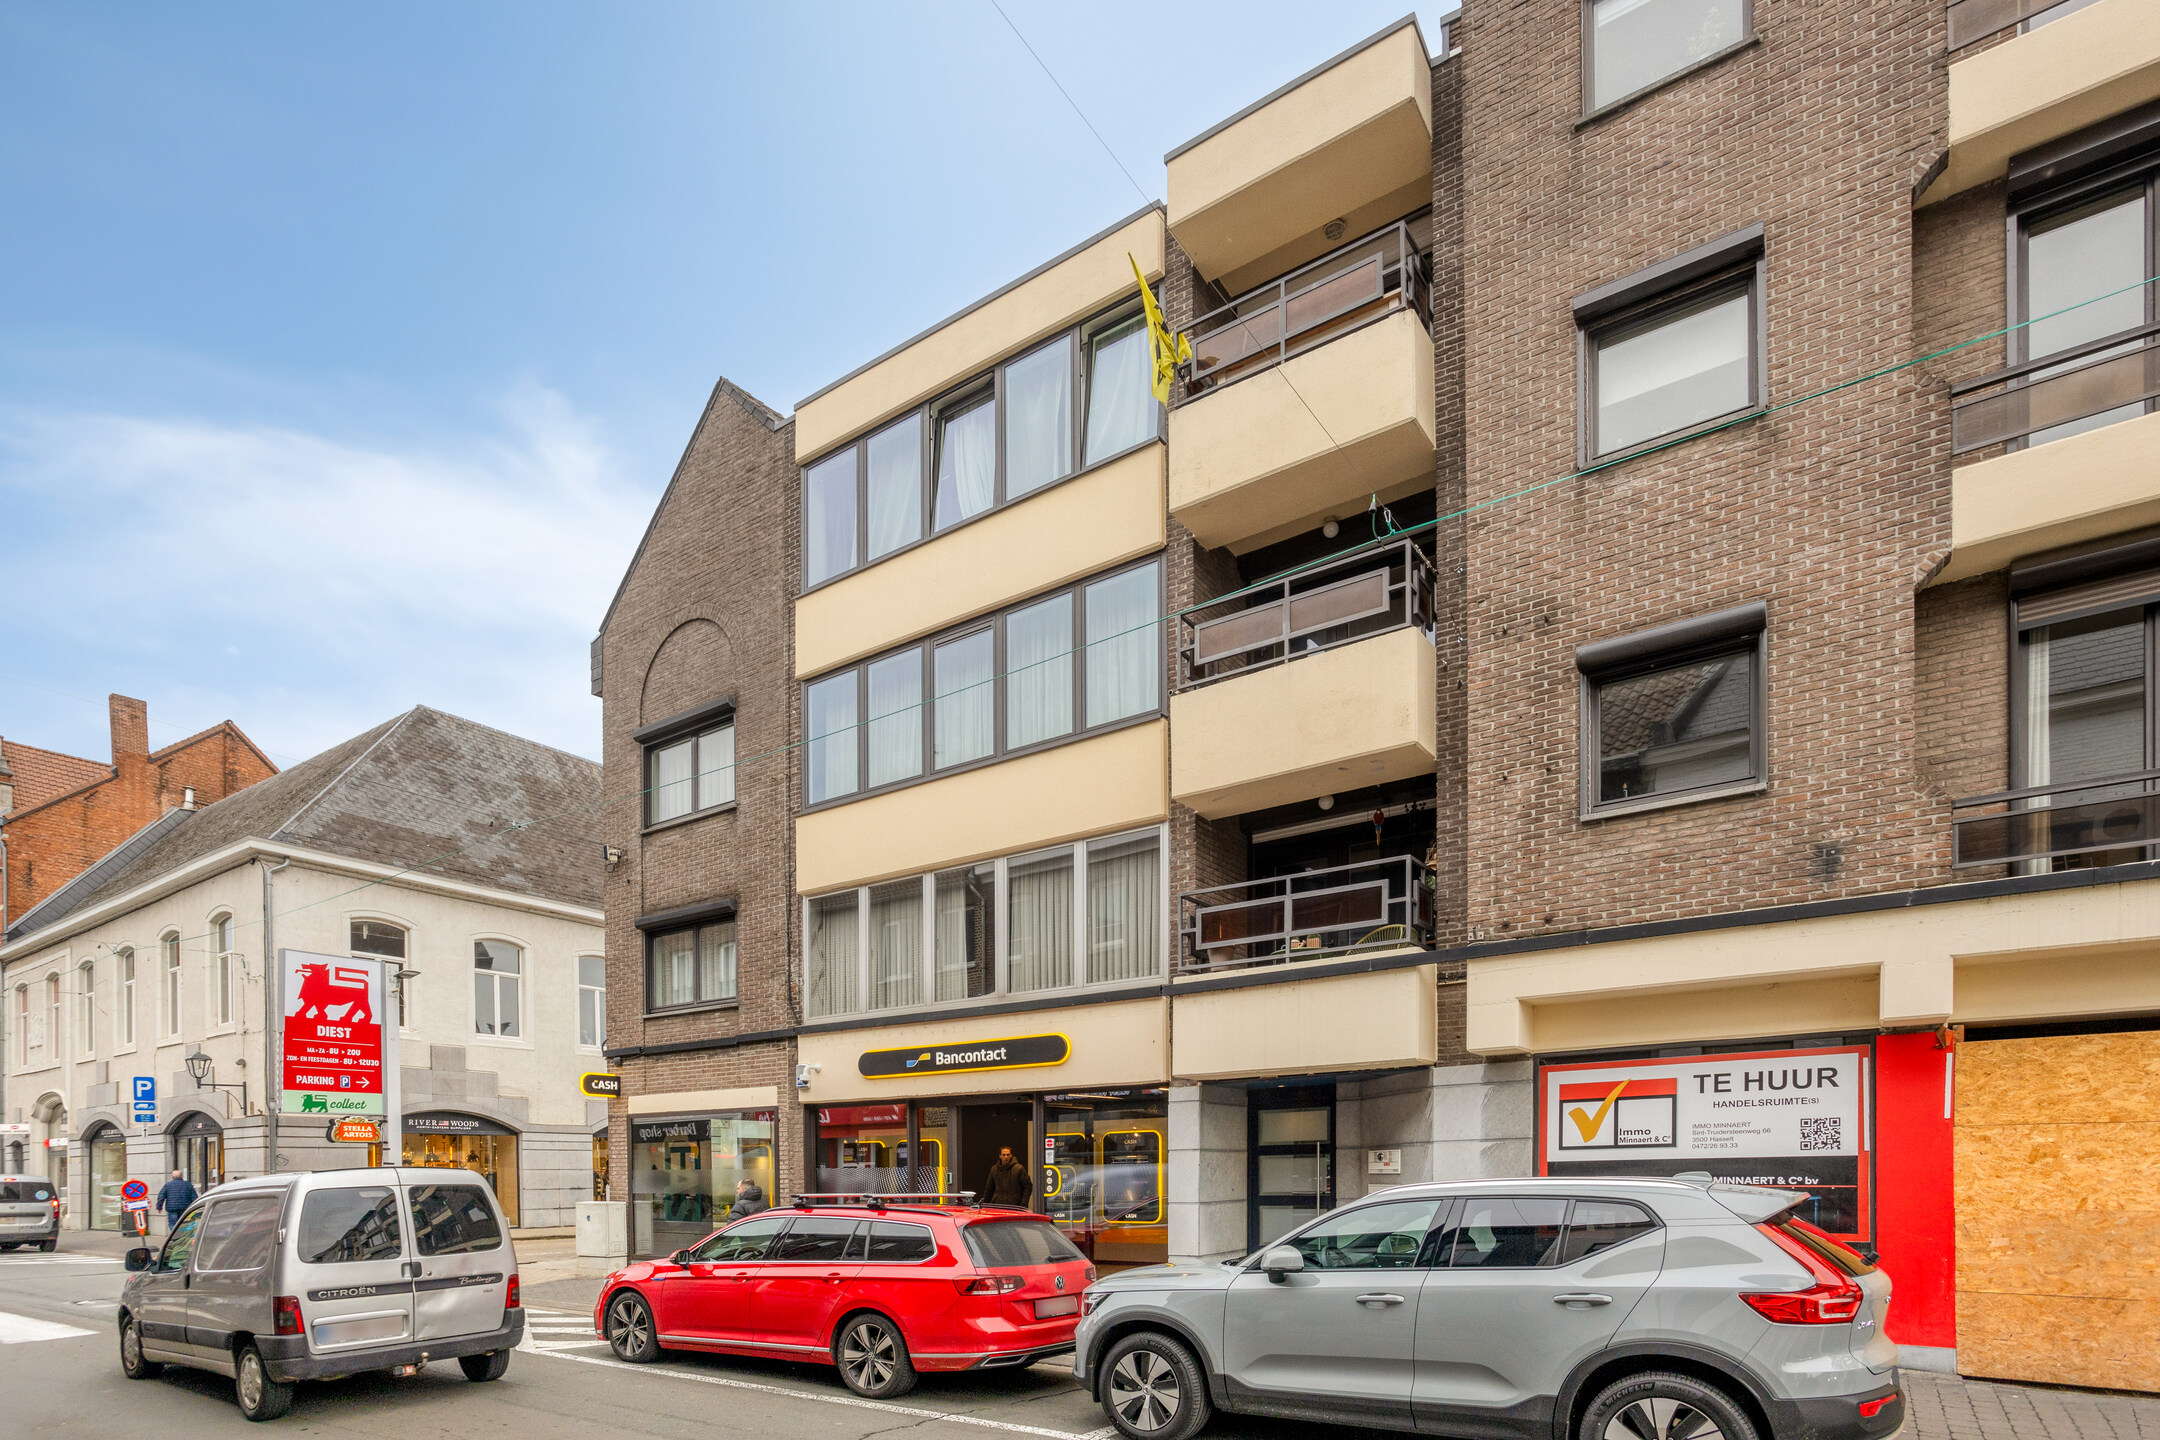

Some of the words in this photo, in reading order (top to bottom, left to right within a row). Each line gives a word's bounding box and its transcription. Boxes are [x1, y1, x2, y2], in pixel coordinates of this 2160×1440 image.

[317, 1025, 352, 1038] DIEST
[935, 1047, 1007, 1066] Bancontact
[358, 1059, 380, 1067] 12U30
[296, 1075, 335, 1085] PARKING
[591, 1080, 618, 1090] CASH
[1693, 1073, 1732, 1094] TE
[1744, 1067, 1840, 1092] HUUR
[136, 1080, 152, 1098] P
[330, 1098, 367, 1110] collect
[1712, 1097, 1820, 1109] HANDELSRUIMTE(S)
[450, 1120, 480, 1128] WOODS
[1619, 1128, 1652, 1136] Immo
[1692, 1128, 1761, 1136] Sint-Truidersteenweg
[1713, 1176, 1775, 1185] MINNAERT
[1776, 1176, 1786, 1185] &
[1804, 1176, 1820, 1185] bv
[318, 1285, 377, 1299] CITROËN
[1605, 1382, 1655, 1406] MICHELIN
